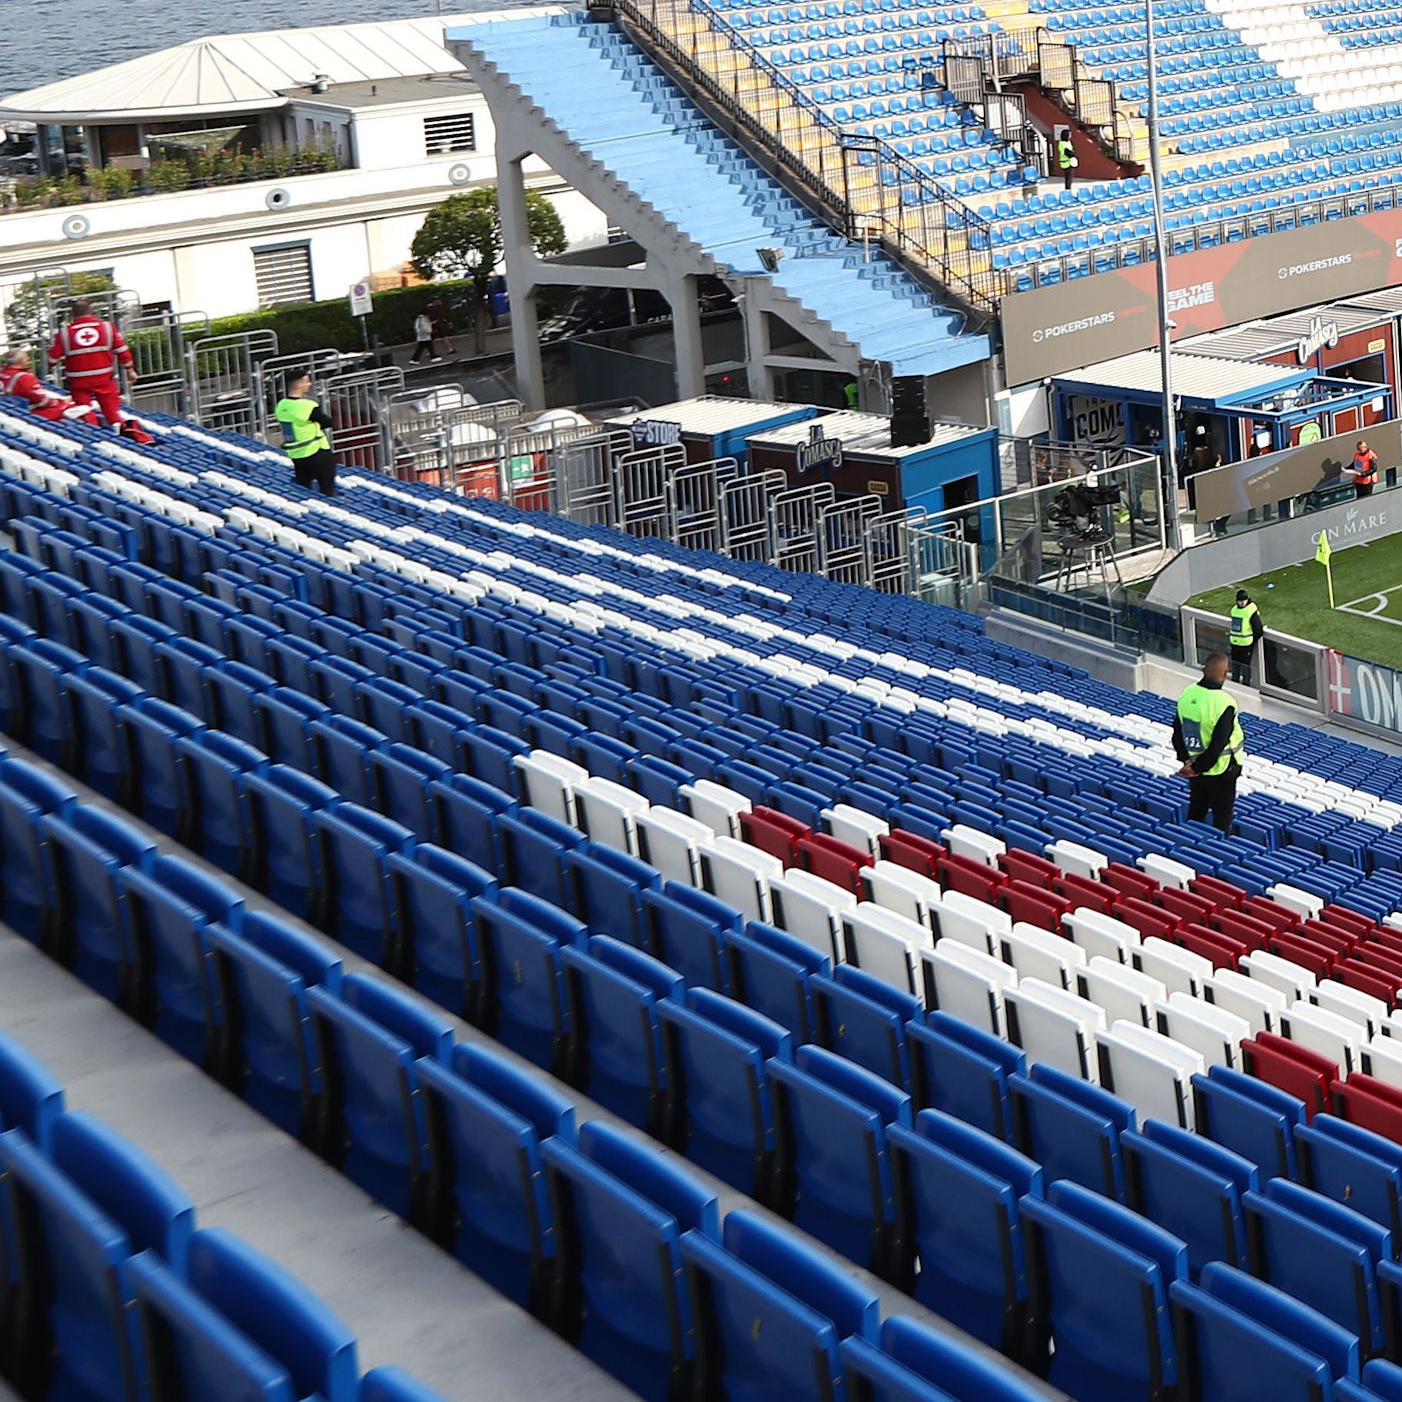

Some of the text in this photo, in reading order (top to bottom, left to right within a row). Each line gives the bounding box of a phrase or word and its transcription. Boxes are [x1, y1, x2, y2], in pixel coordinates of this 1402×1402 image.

[1289, 254, 1352, 278] POKERSTARS
[1167, 281, 1214, 302] EEL THE
[1045, 312, 1115, 340] POKERSTARS
[647, 421, 681, 445] STORE
[810, 425, 824, 441] LA
[1311, 528, 1339, 545] GN
[1344, 512, 1388, 537] MARE
